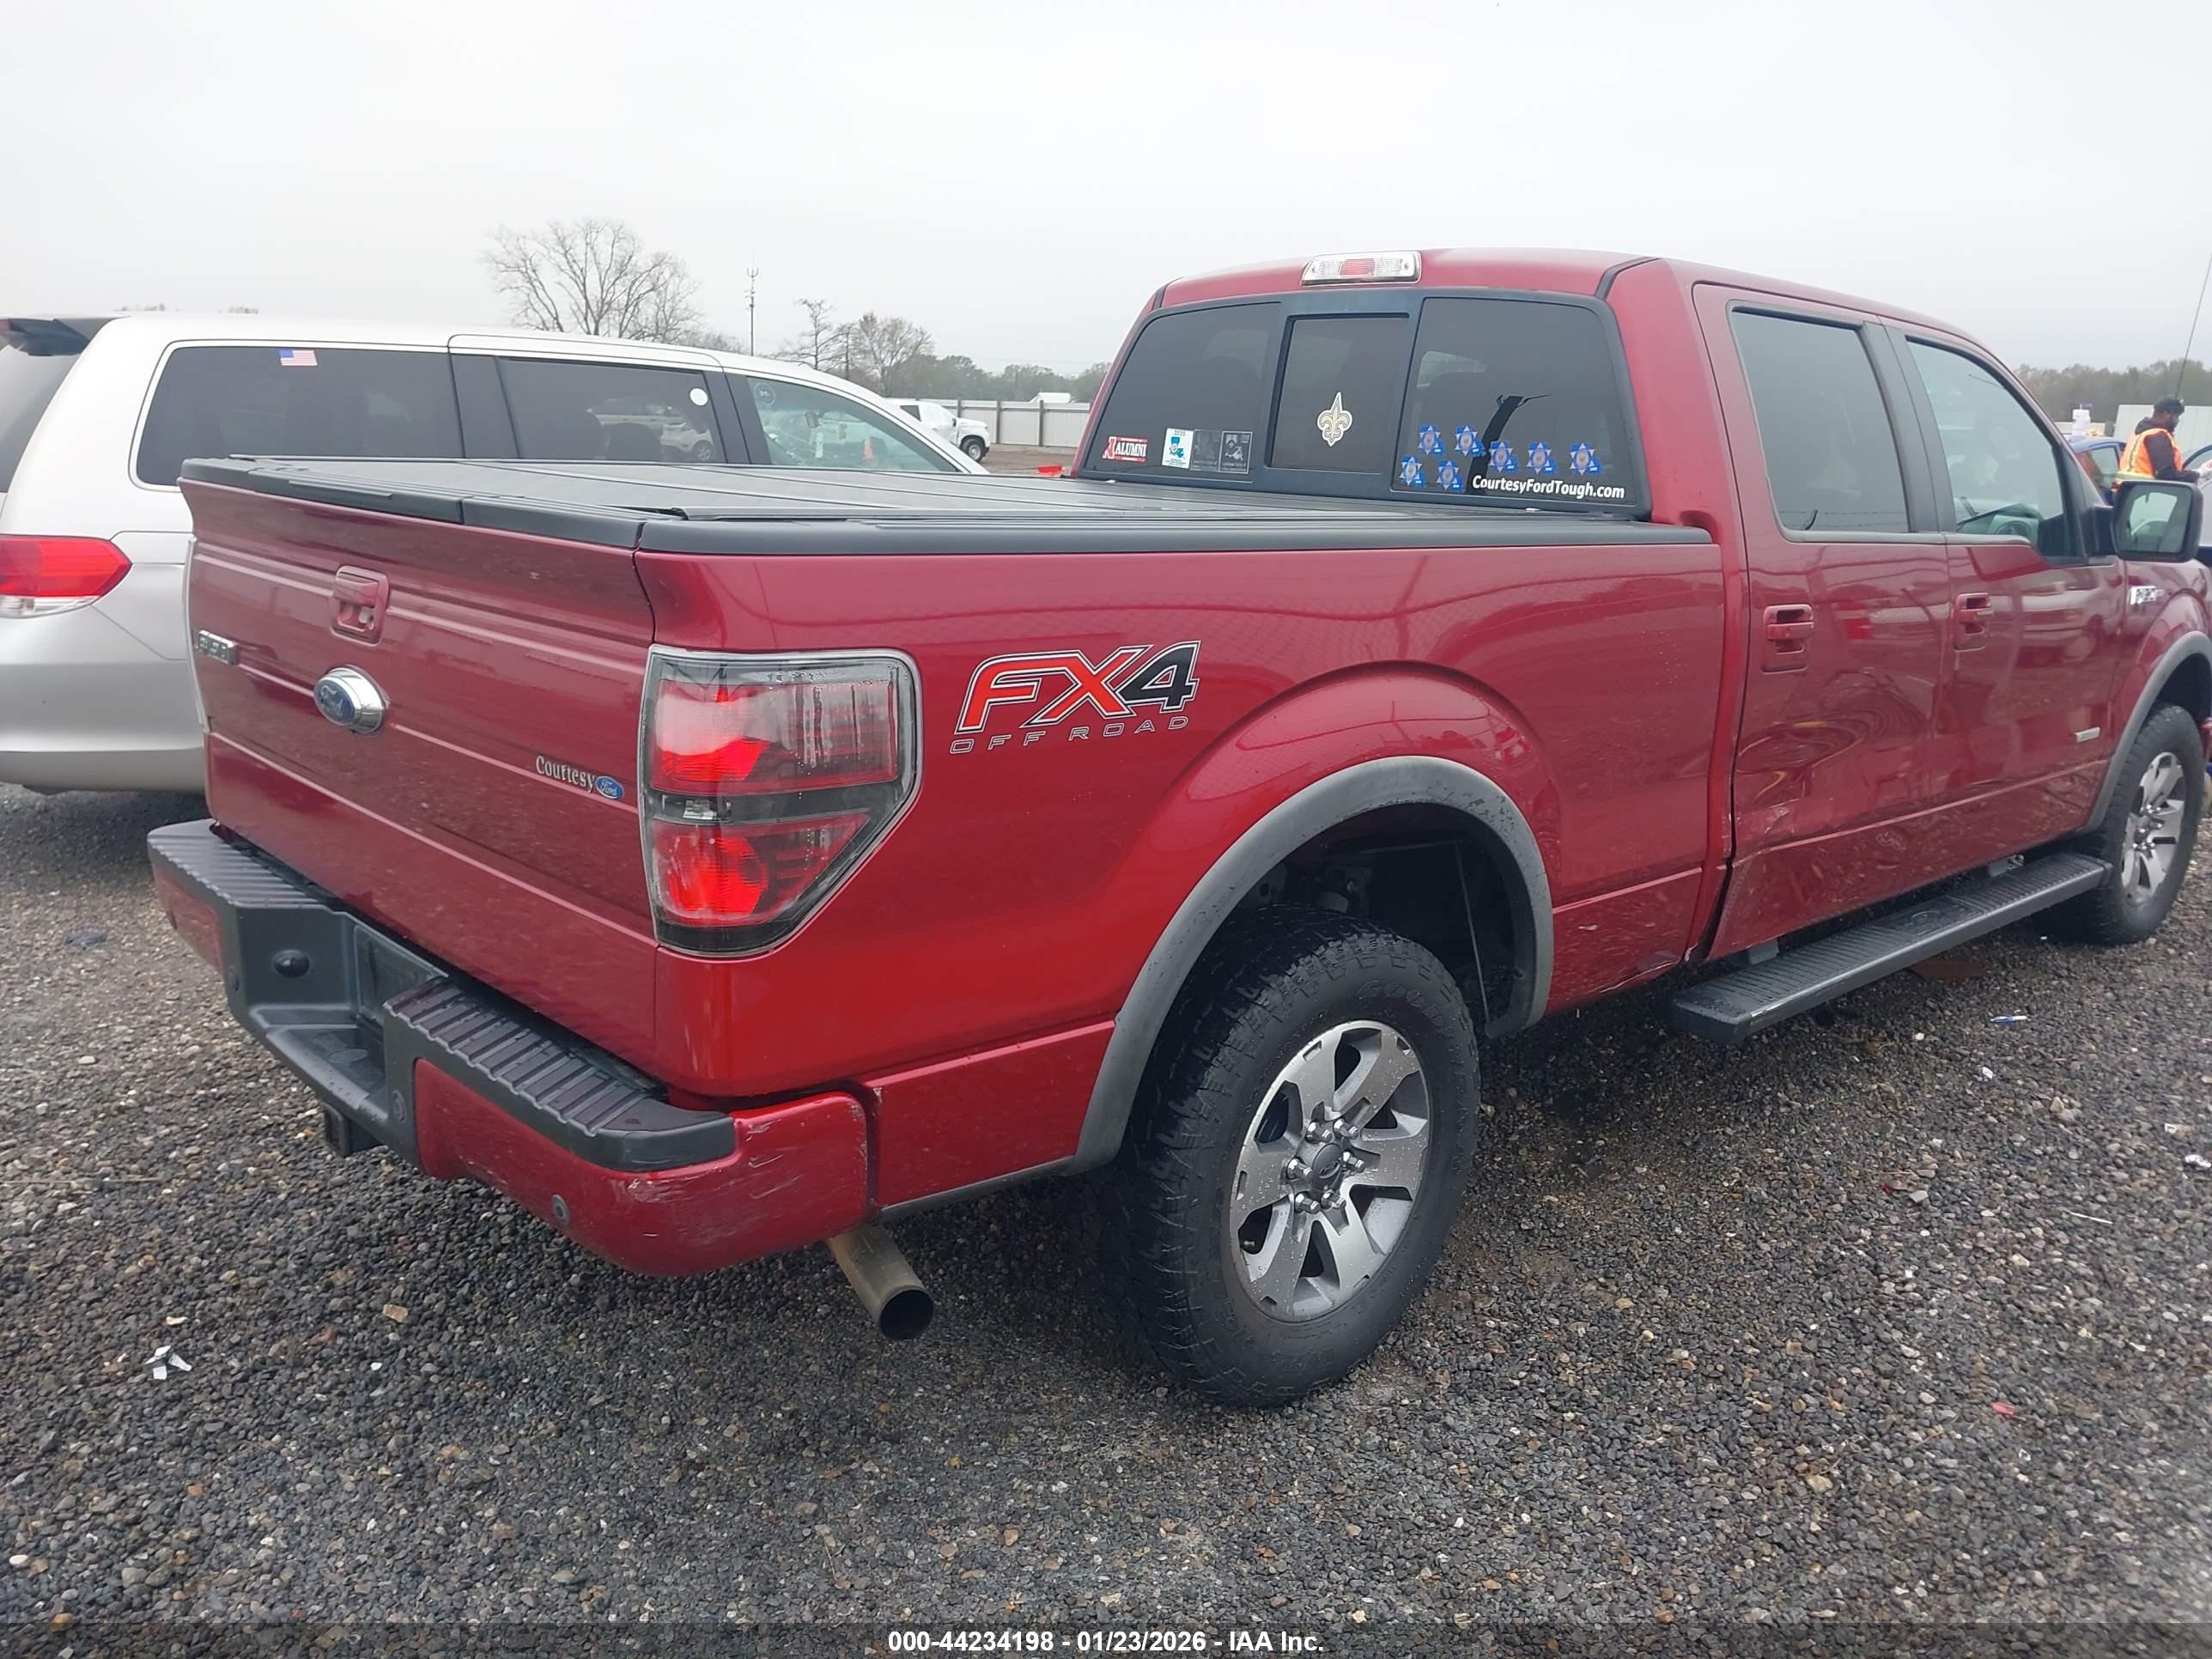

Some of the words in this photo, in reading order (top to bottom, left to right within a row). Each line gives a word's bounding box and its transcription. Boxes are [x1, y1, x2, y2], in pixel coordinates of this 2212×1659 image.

[1115, 442, 1147, 457] ALUMNI
[1473, 475, 1625, 499] CourtesyFordTough.com
[955, 641, 1200, 735] FX4
[950, 731, 1046, 754] OFF
[1068, 716, 1188, 741] ROAD
[536, 755, 596, 793] Courtesy
[599, 778, 618, 797] Ford
